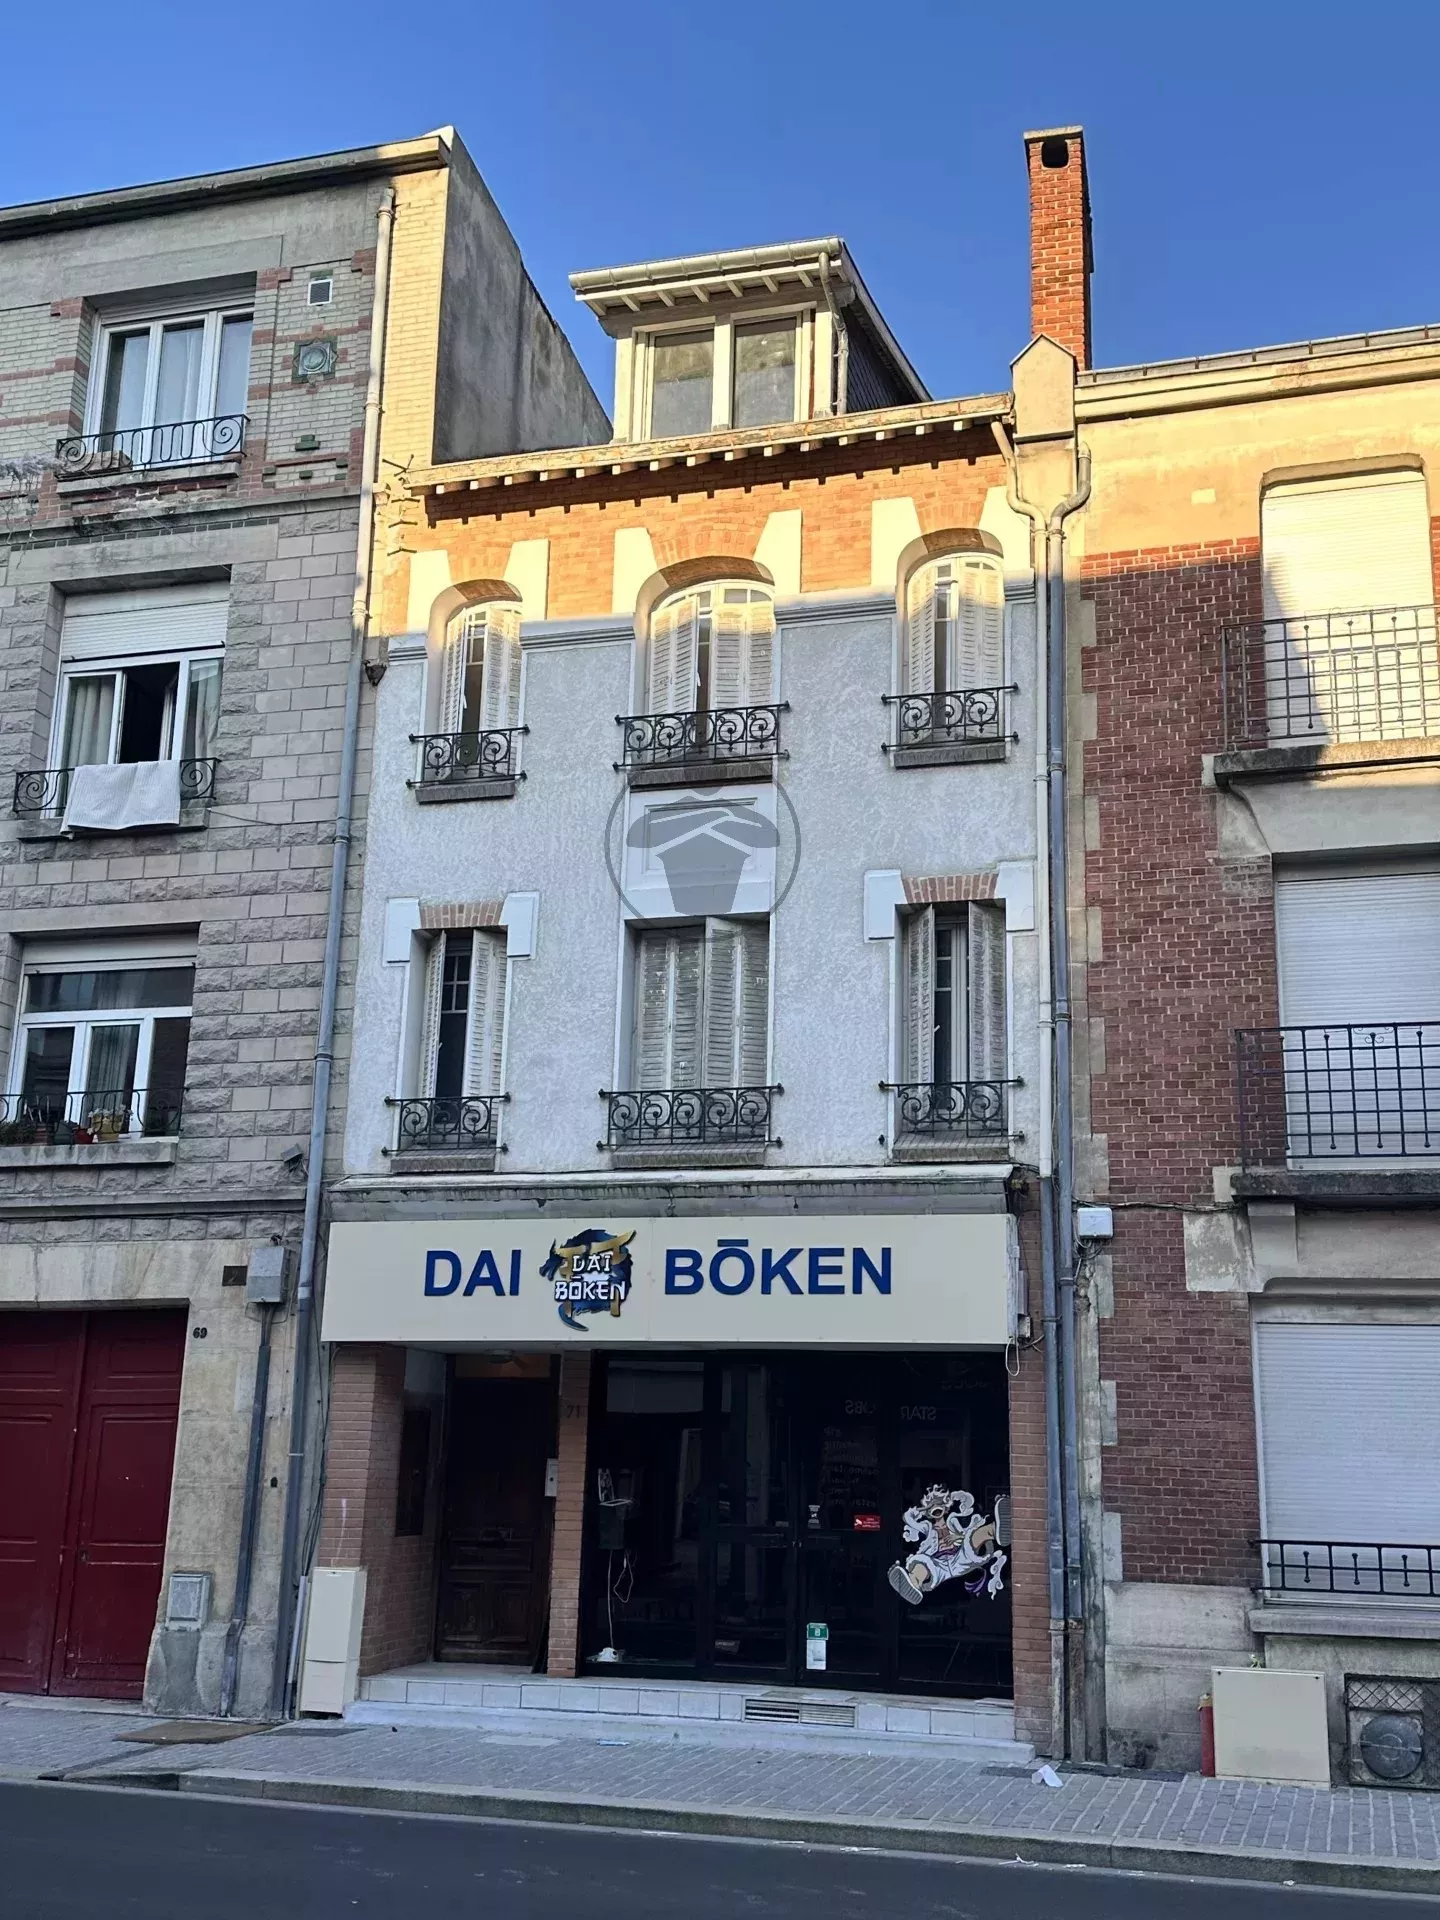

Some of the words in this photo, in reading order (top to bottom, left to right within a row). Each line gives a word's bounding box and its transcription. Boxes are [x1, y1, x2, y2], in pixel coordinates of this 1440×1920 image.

[424, 1249, 522, 1297] DAI
[664, 1238, 892, 1296] BŌKEN
[572, 1253, 612, 1272] DAI
[192, 1327, 208, 1339] 69
[567, 1403, 581, 1419] 71
